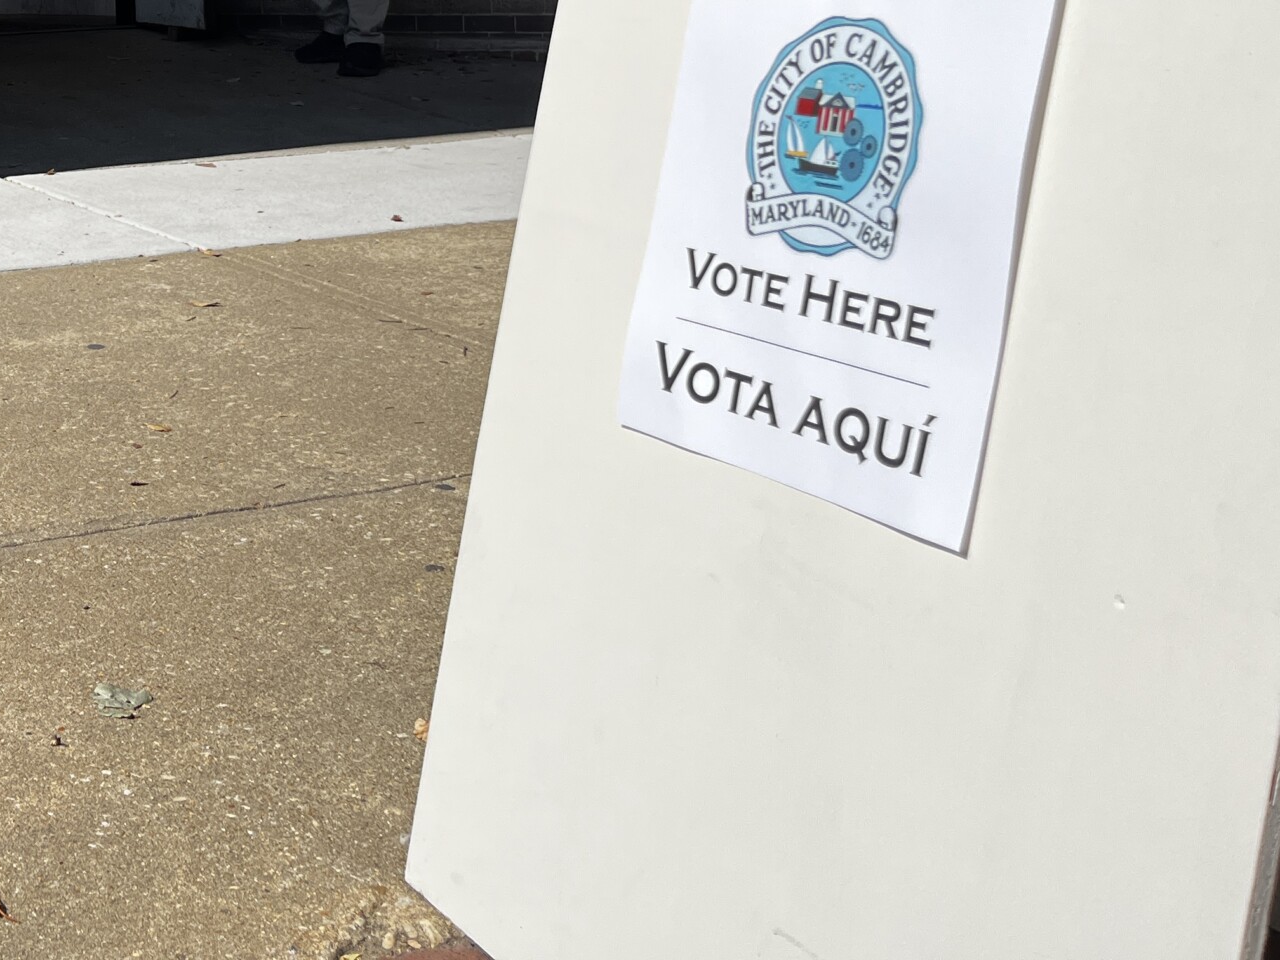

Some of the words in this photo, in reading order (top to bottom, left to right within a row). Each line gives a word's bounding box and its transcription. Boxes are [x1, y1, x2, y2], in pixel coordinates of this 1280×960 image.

[810, 31, 838, 63] OF
[764, 50, 807, 116] CITY
[845, 32, 910, 199] CAMBRIDGE
[756, 119, 777, 179] THE
[750, 201, 851, 228] MARYLAND
[855, 220, 890, 253] 1684
[685, 246, 790, 312] VOTE
[799, 273, 937, 350] HERE
[655, 340, 780, 430] VOTA
[792, 394, 939, 478] AQUÍ
